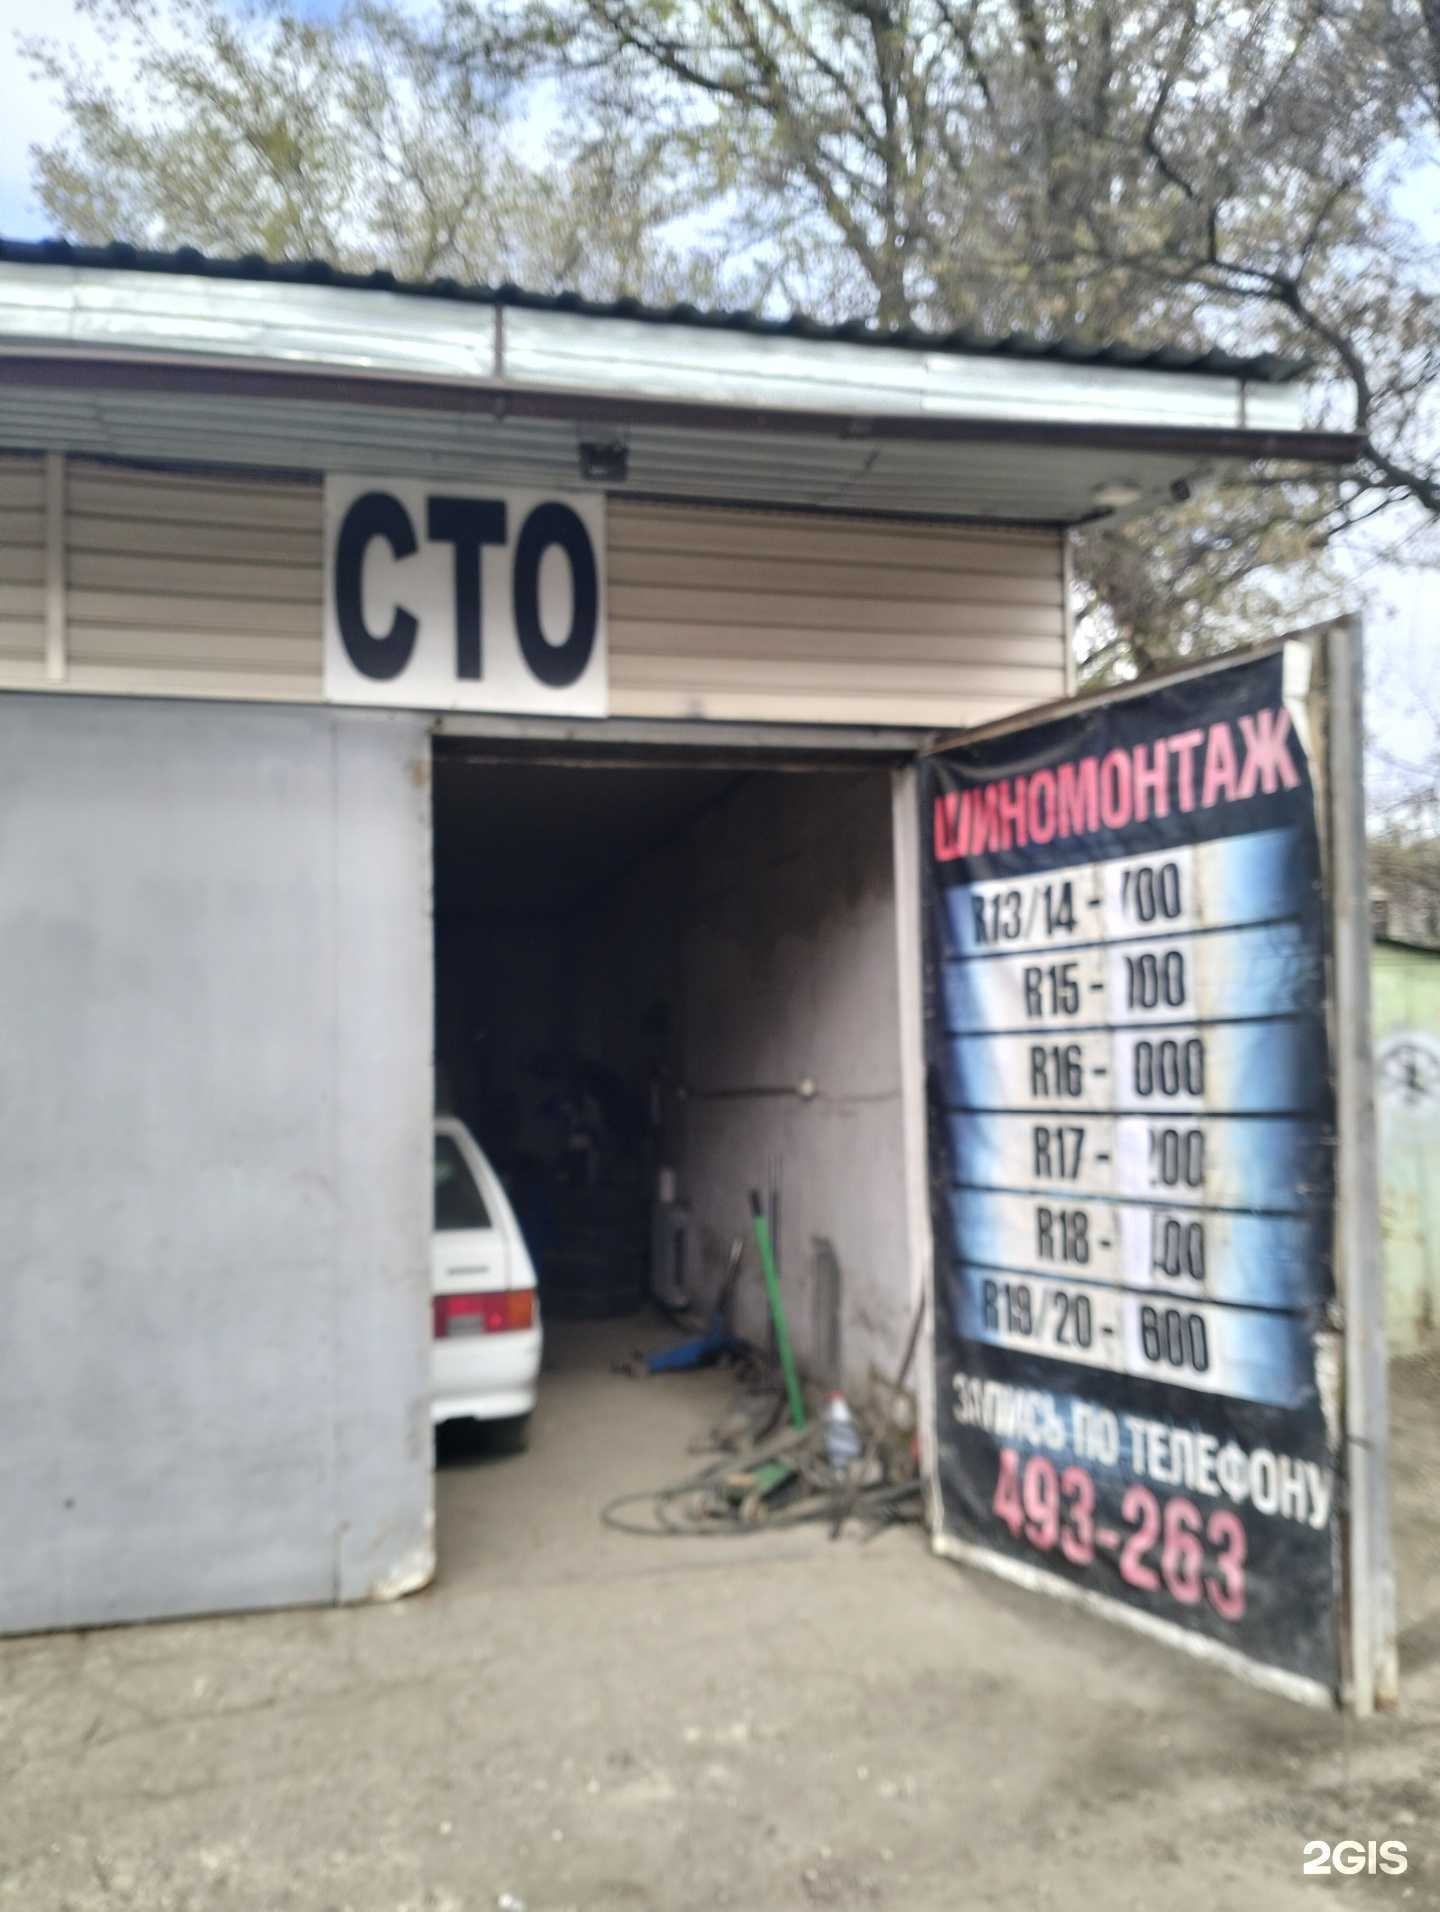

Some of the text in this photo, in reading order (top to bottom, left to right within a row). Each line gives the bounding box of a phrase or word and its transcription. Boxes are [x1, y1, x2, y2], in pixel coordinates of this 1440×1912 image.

[335, 489, 598, 690] СТО
[933, 706, 1300, 862] ШИНОМОНТАЖ
[993, 1447, 1248, 1622] 493-263
[1071, 1400, 1121, 1467] ПО
[1127, 1413, 1331, 1531] ТЕЛЕФОНУ
